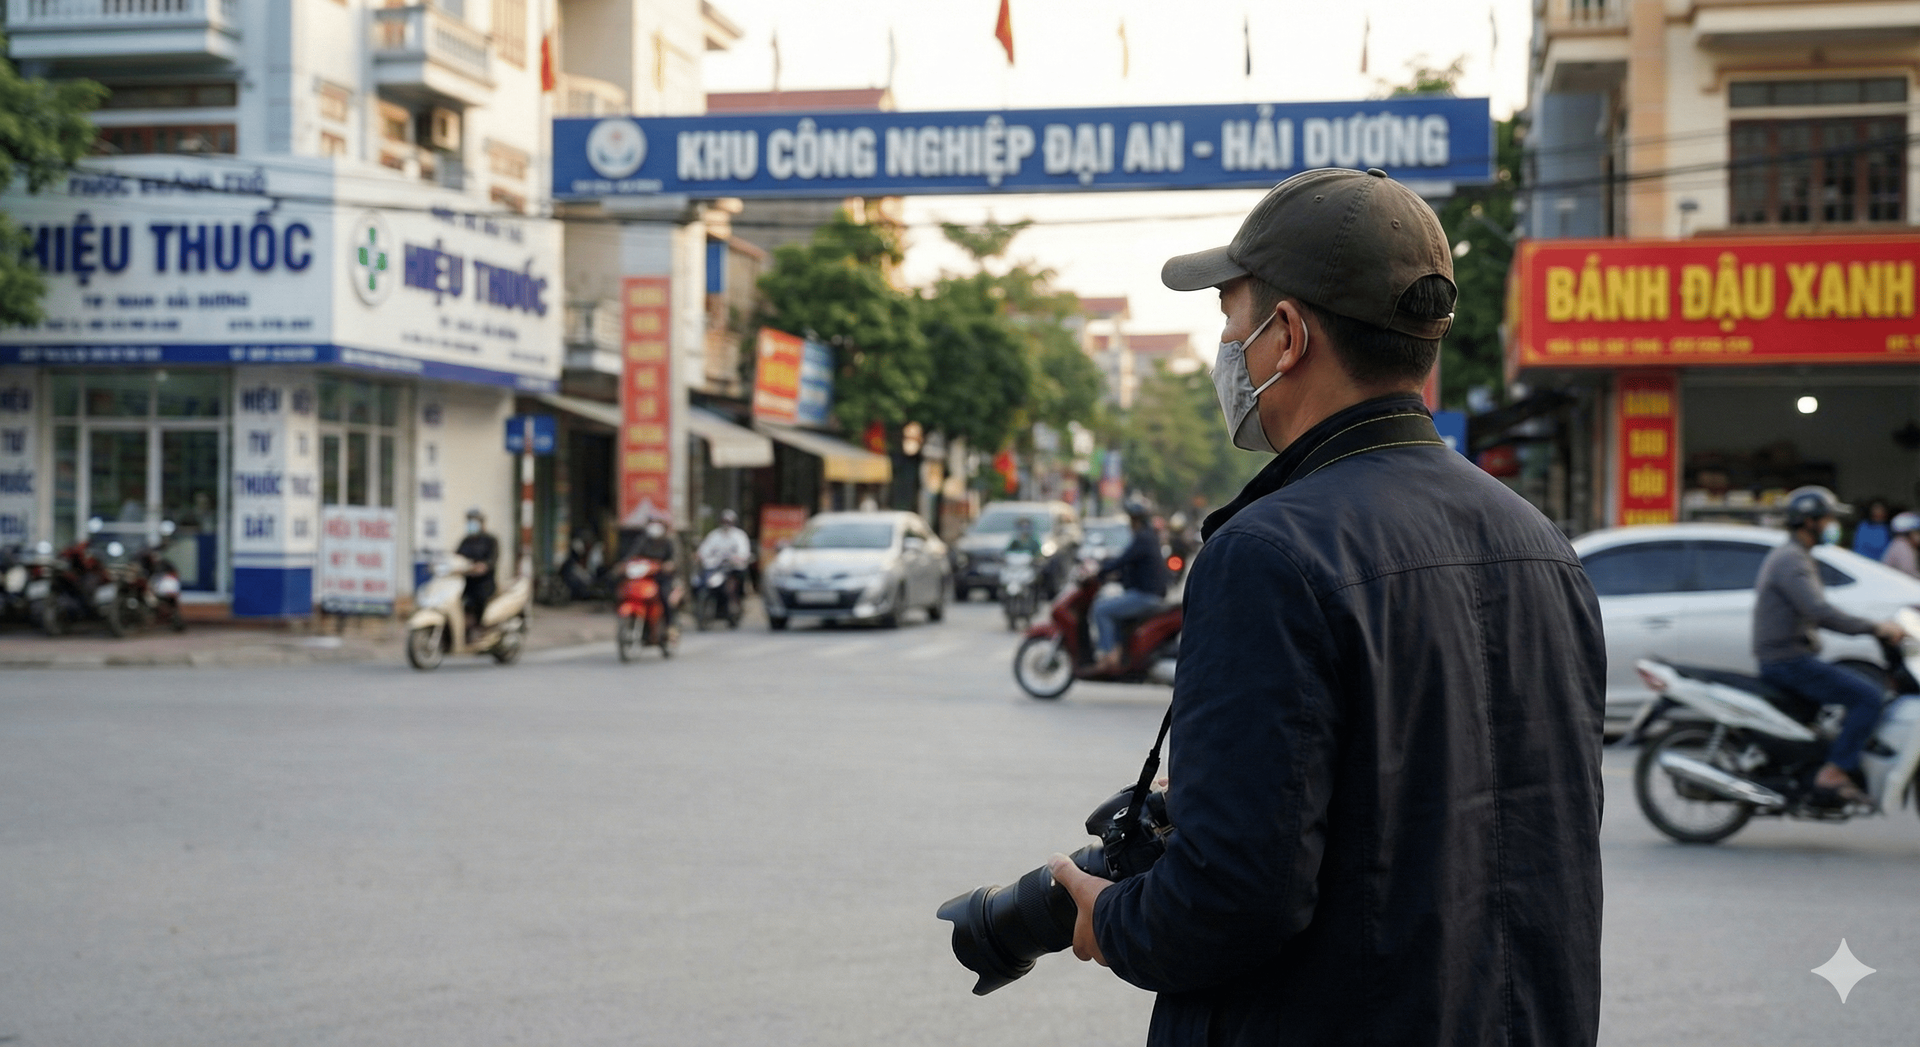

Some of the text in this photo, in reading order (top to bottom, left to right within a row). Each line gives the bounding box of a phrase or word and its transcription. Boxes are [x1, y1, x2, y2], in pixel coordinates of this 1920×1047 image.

[676, 103, 1451, 188] KHU CÔNG NGHIỆP ĐẠI AN - HẢI DƯƠNG
[148, 199, 313, 274] THUỐC
[403, 237, 549, 318] HIỆU THUỐC
[1545, 251, 1916, 333] BÁNH ĐẬU XANH
